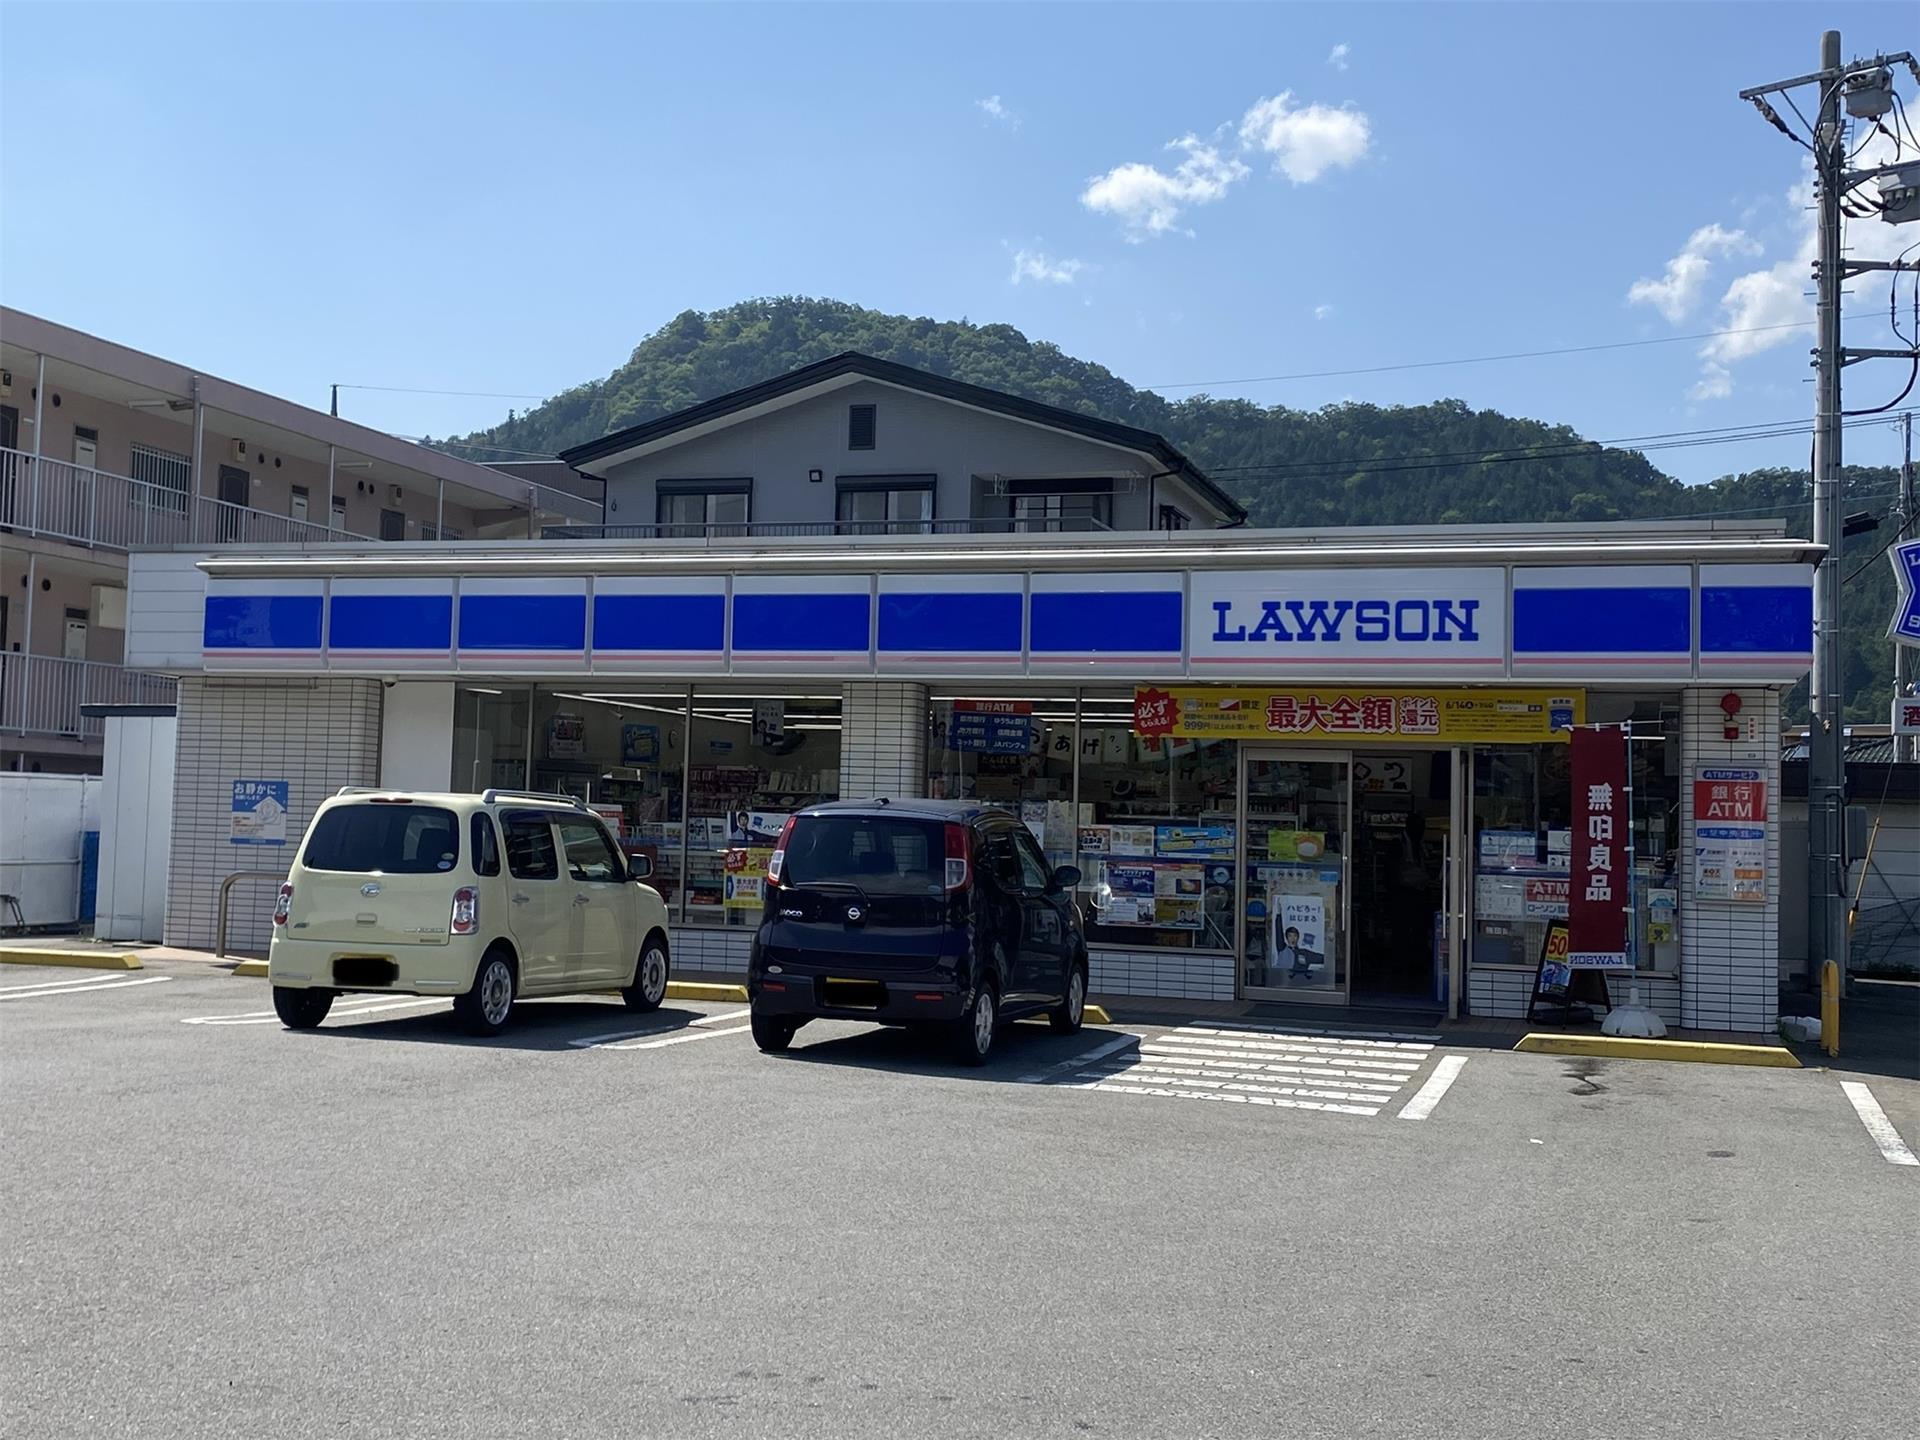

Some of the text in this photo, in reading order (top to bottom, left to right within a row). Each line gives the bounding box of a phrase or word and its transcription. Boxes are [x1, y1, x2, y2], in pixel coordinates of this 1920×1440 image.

[1212, 600, 1479, 642] LAWSON
[976, 702, 1014, 712] 銀行ATM
[1137, 699, 1168, 719] 必ず
[1401, 699, 1437, 709] ポイント
[1267, 696, 1395, 731] 最大全額
[1401, 709, 1437, 726] 還元
[1705, 771, 1757, 780] ATMサービス
[1711, 785, 1751, 801] 銀行
[1707, 801, 1752, 817] ATM
[1533, 882, 1569, 895] ATM
